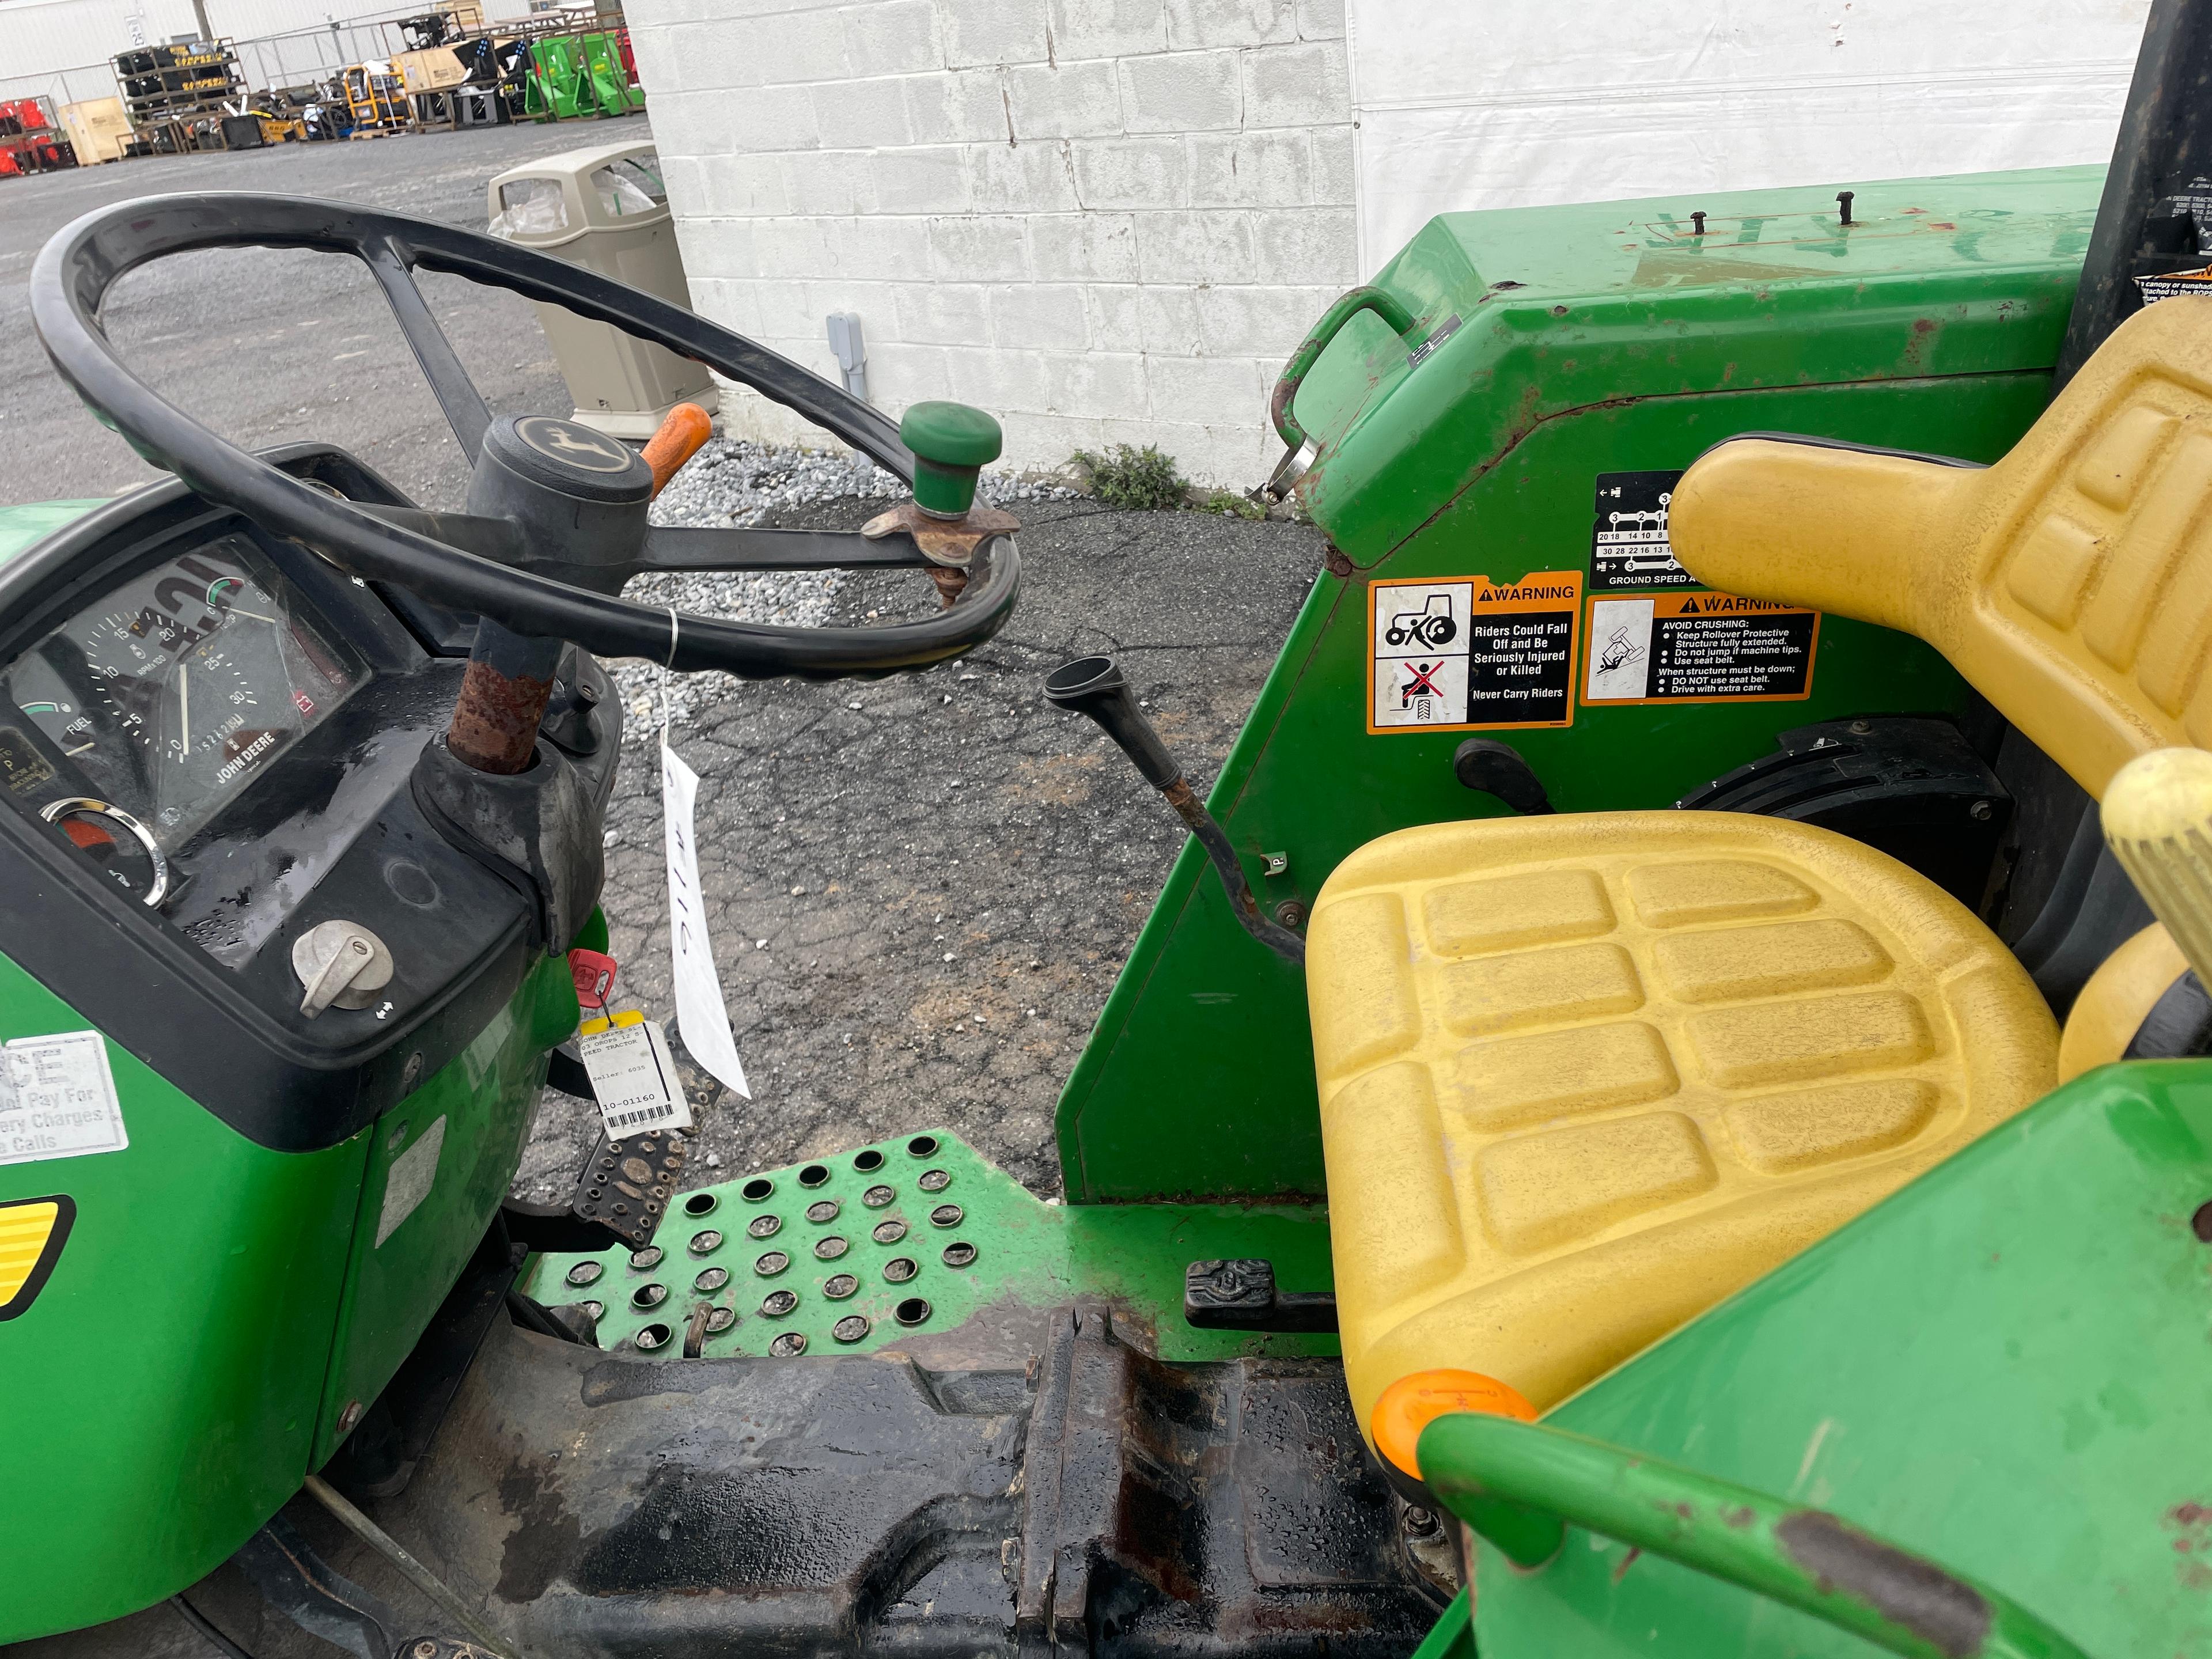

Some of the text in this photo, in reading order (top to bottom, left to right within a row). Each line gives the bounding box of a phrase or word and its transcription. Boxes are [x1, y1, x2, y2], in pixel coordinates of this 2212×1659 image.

[1609, 577, 1652, 585] GROUND
[1654, 575, 1687, 584] SPEED
[1494, 586, 1574, 601] WARNING
[1475, 623, 1567, 637] Riders Could Fall
[1662, 620, 1749, 630] AVOID CRUSHING:
[114, 627, 129, 641] 15
[159, 627, 175, 642] 20
[1677, 629, 1789, 641] Keep Rollover Protective
[1493, 638, 1548, 650] Off and Be
[1676, 637, 1787, 648] Structure fully extended.
[1474, 650, 1565, 665] Seriously Injured
[1706, 648, 1730, 658] jump
[1733, 647, 1740, 655] if
[1741, 646, 1781, 654] machine
[1782, 646, 1802, 655] tips.
[204, 657, 220, 671] 25
[1674, 656, 1734, 665] Use seat belt.
[103, 665, 119, 679] 10
[1497, 664, 1541, 676] or Killed
[1658, 668, 1684, 676] When
[1686, 667, 1727, 675] structure
[1729, 666, 1752, 674] must
[1767, 665, 1795, 673] down;
[1672, 677, 1687, 685] DO
[1689, 676, 1709, 684] NOT
[229, 691, 245, 704] 30
[1473, 688, 1563, 700] Never Carry Riders
[130, 713, 143, 724] 5
[66, 717, 92, 735] FUEL
[170, 739, 182, 750] 0
[217, 755, 246, 784] JOHN
[241, 731, 276, 763] DEERE
[581, 1035, 597, 1044] JOHN
[594, 1037, 618, 1046] OROPS
[584, 1039, 638, 1056] PEED TRACTOR
[28, 1092, 59, 1108] Pay
[64, 1088, 93, 1103] For
[603, 1093, 655, 1111] 10-01160
[31, 1109, 103, 1128] Charges
[13, 1134, 57, 1152] Calls
